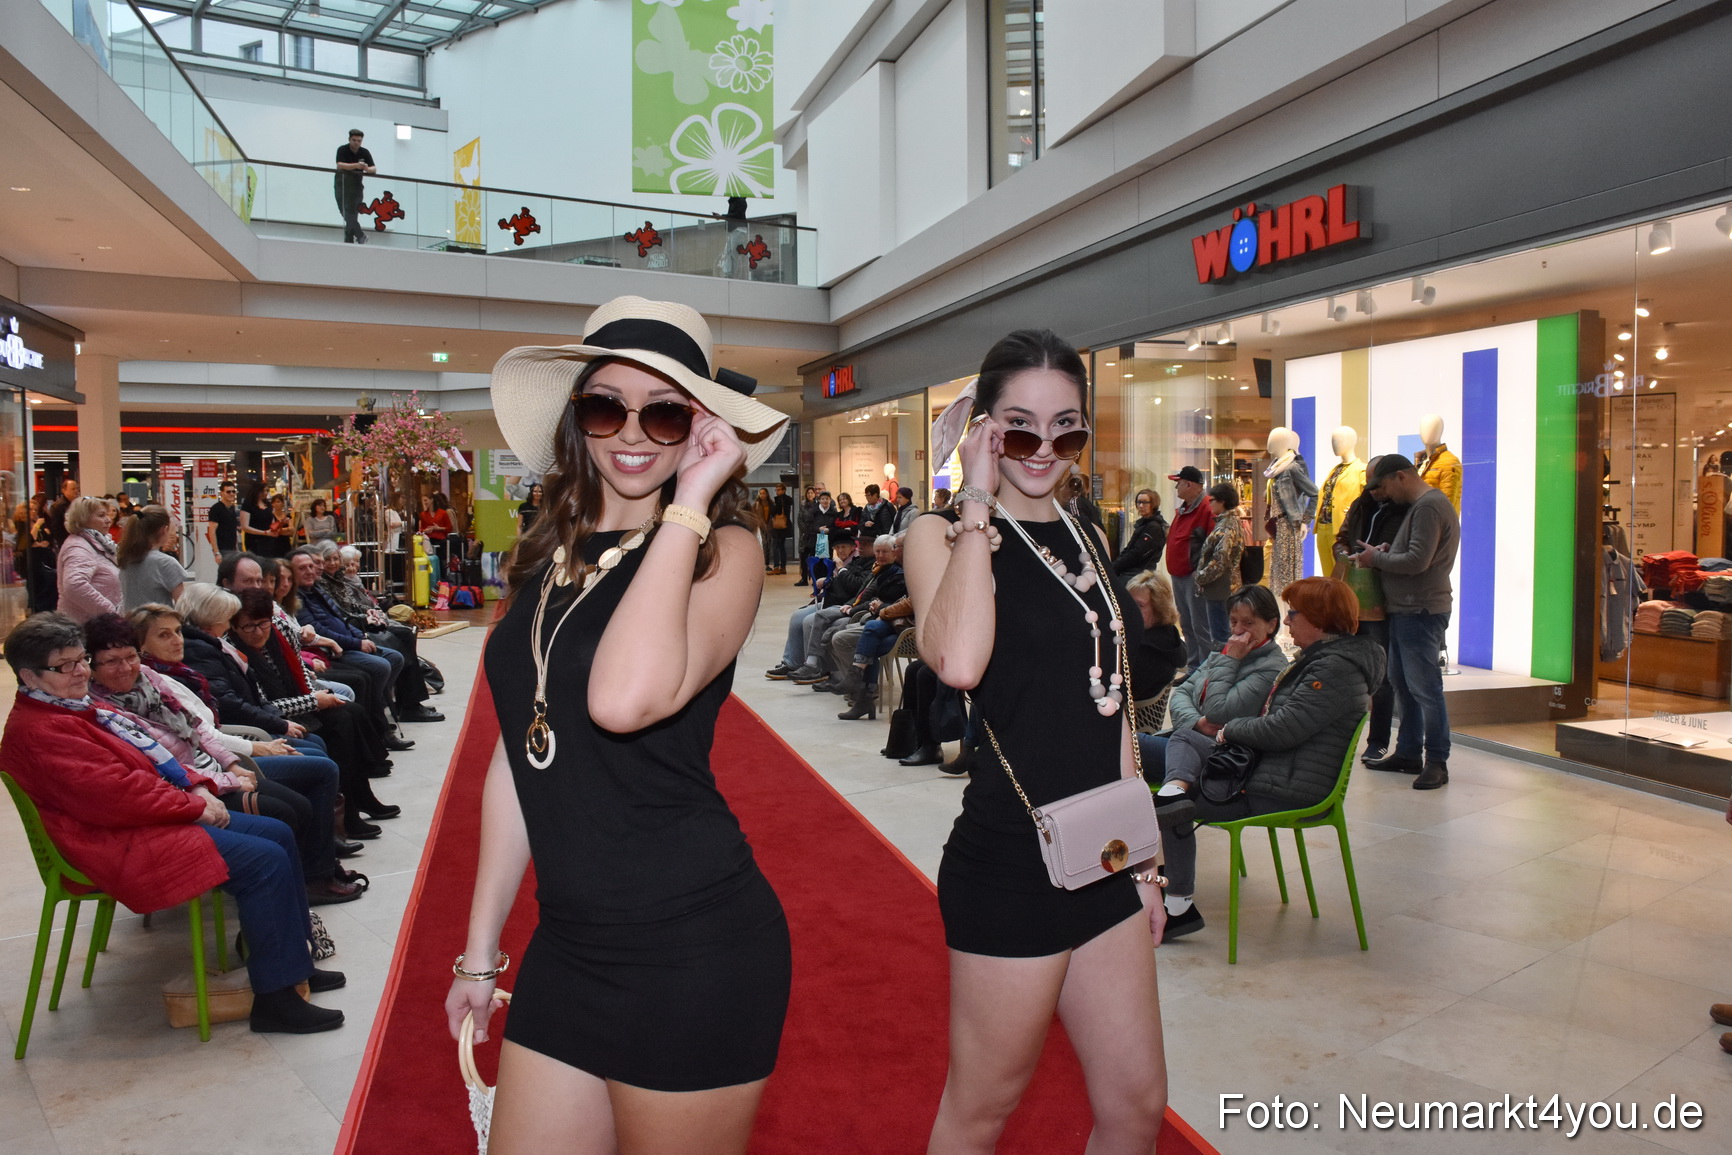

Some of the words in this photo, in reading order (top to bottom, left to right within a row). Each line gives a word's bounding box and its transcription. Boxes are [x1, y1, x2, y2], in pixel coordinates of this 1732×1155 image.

[1192, 184, 1360, 284] WÖHRL
[822, 365, 855, 398] WÖHRL
[170, 483, 181, 521] Markt
[1688, 717, 1708, 731] JUNE
